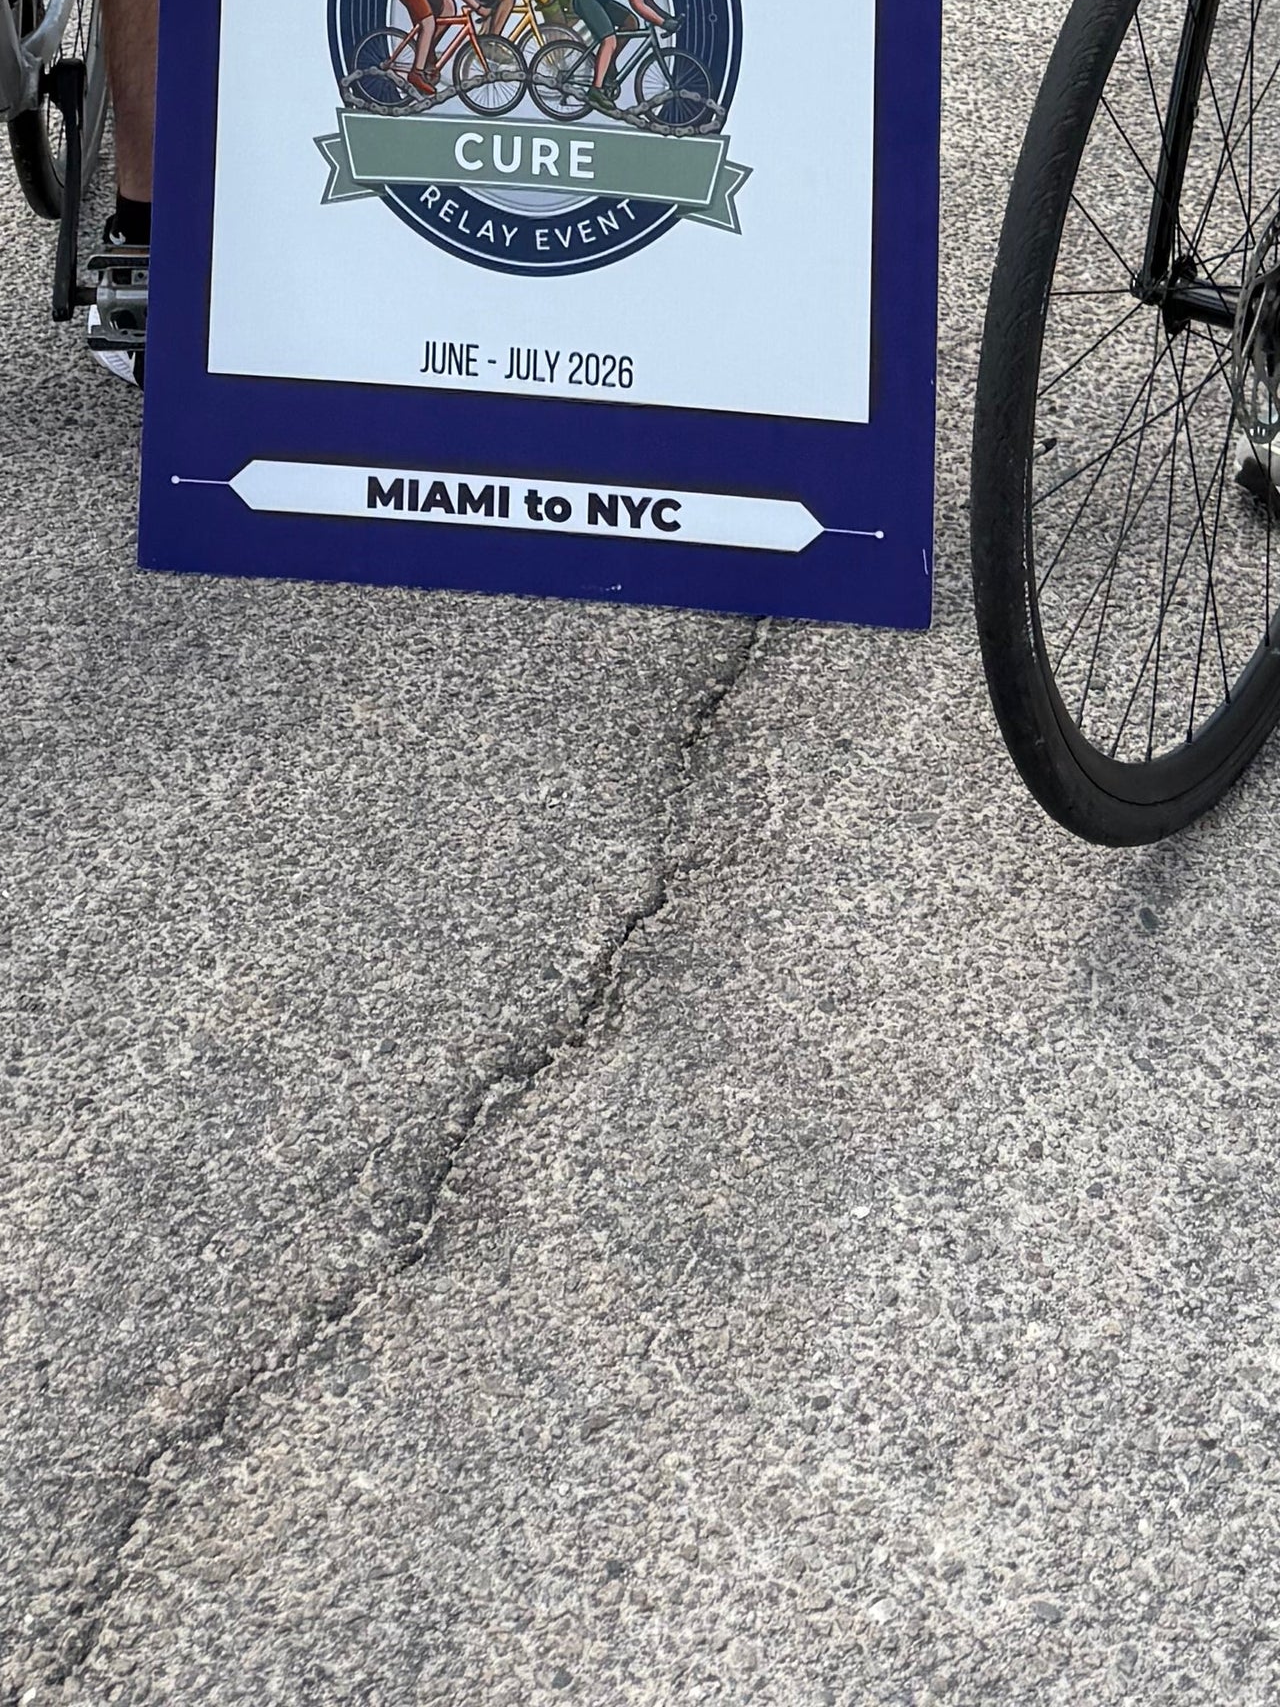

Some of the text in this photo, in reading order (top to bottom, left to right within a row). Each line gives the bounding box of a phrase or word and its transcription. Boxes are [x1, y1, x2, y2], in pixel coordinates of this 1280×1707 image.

[453, 132, 597, 180] CURE
[418, 185, 640, 251] RELAY EVENT
[419, 340, 480, 377] JUNE
[504, 346, 561, 383] JULY
[568, 351, 634, 389] 2026
[366, 475, 683, 534] MIAMI to NYC
